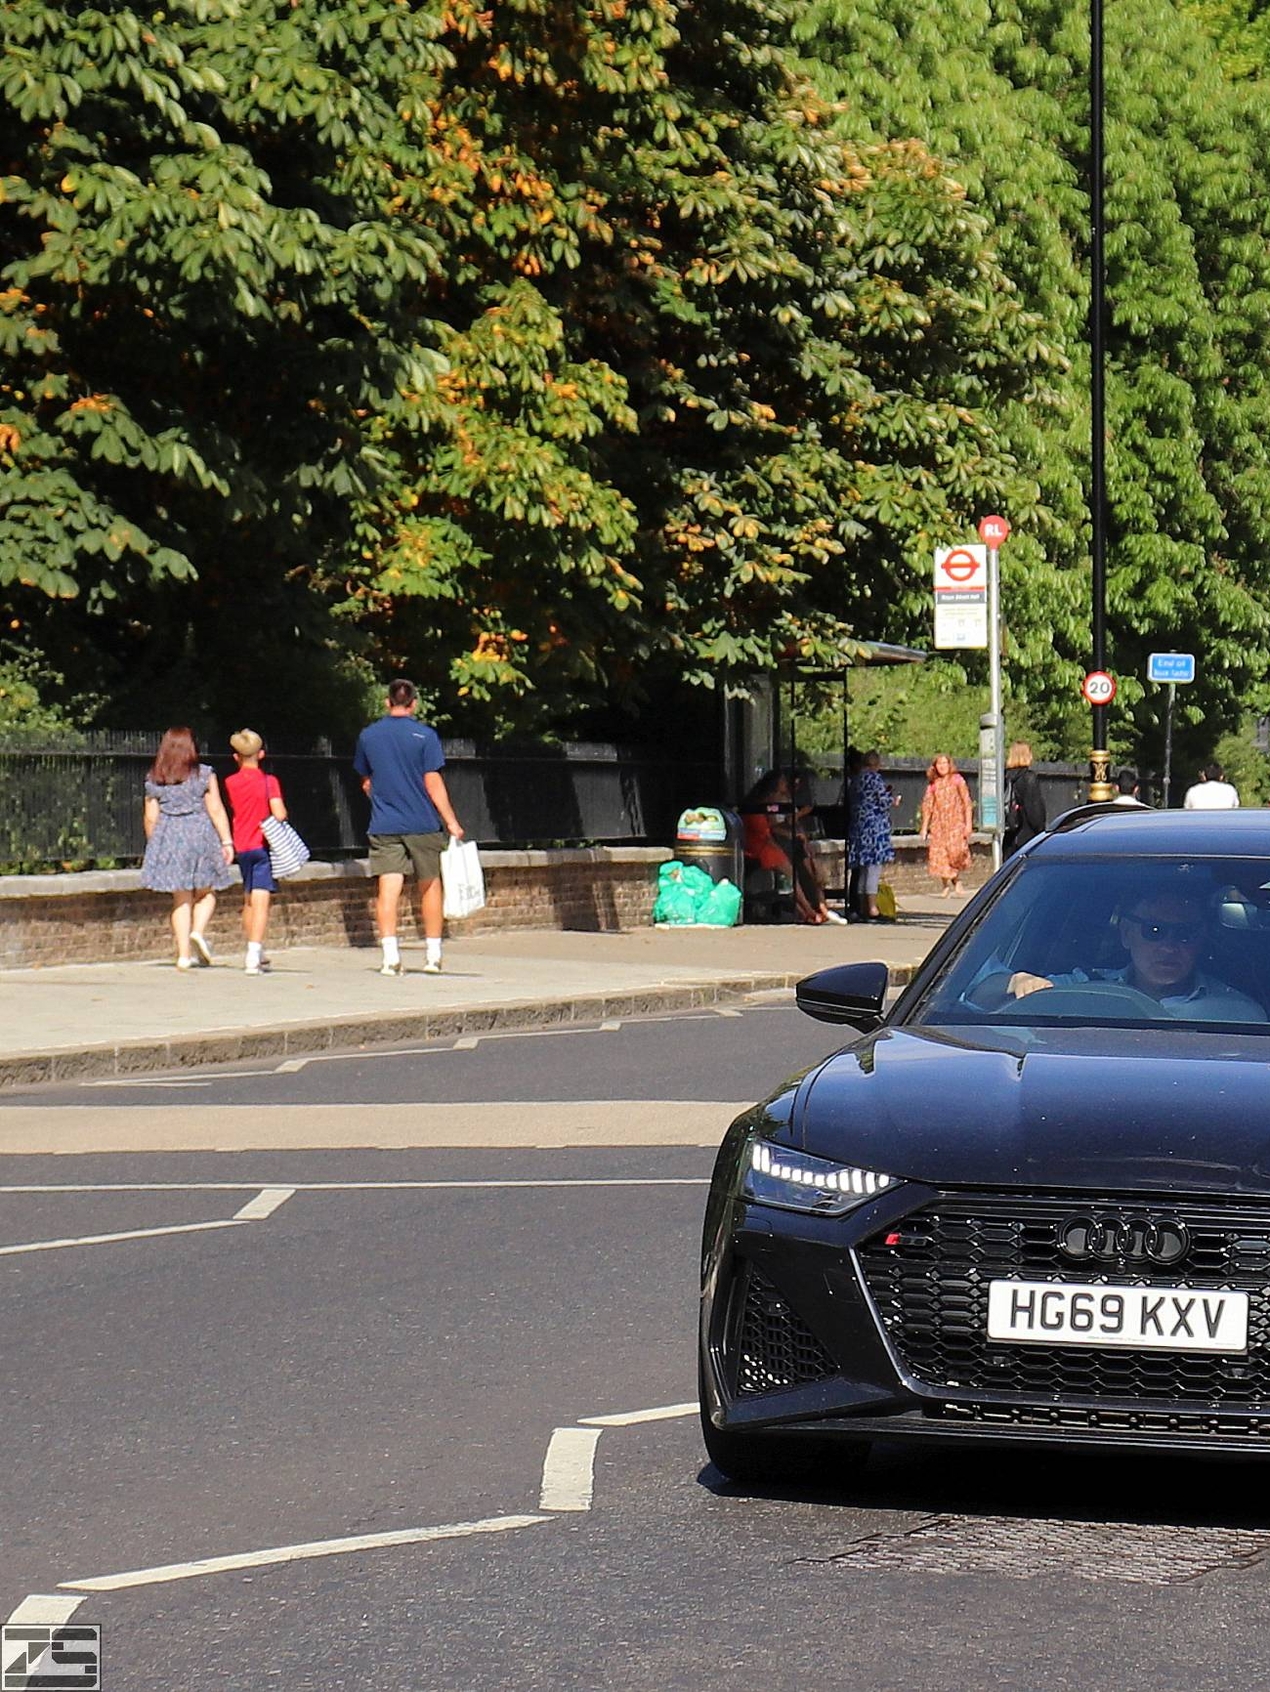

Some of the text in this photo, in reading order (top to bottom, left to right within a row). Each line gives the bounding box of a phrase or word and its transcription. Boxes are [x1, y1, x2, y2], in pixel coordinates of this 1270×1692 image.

[984, 523, 1003, 537] RL
[1089, 680, 1110, 695] 20
[1009, 1288, 1227, 1339] HG69 KXV
